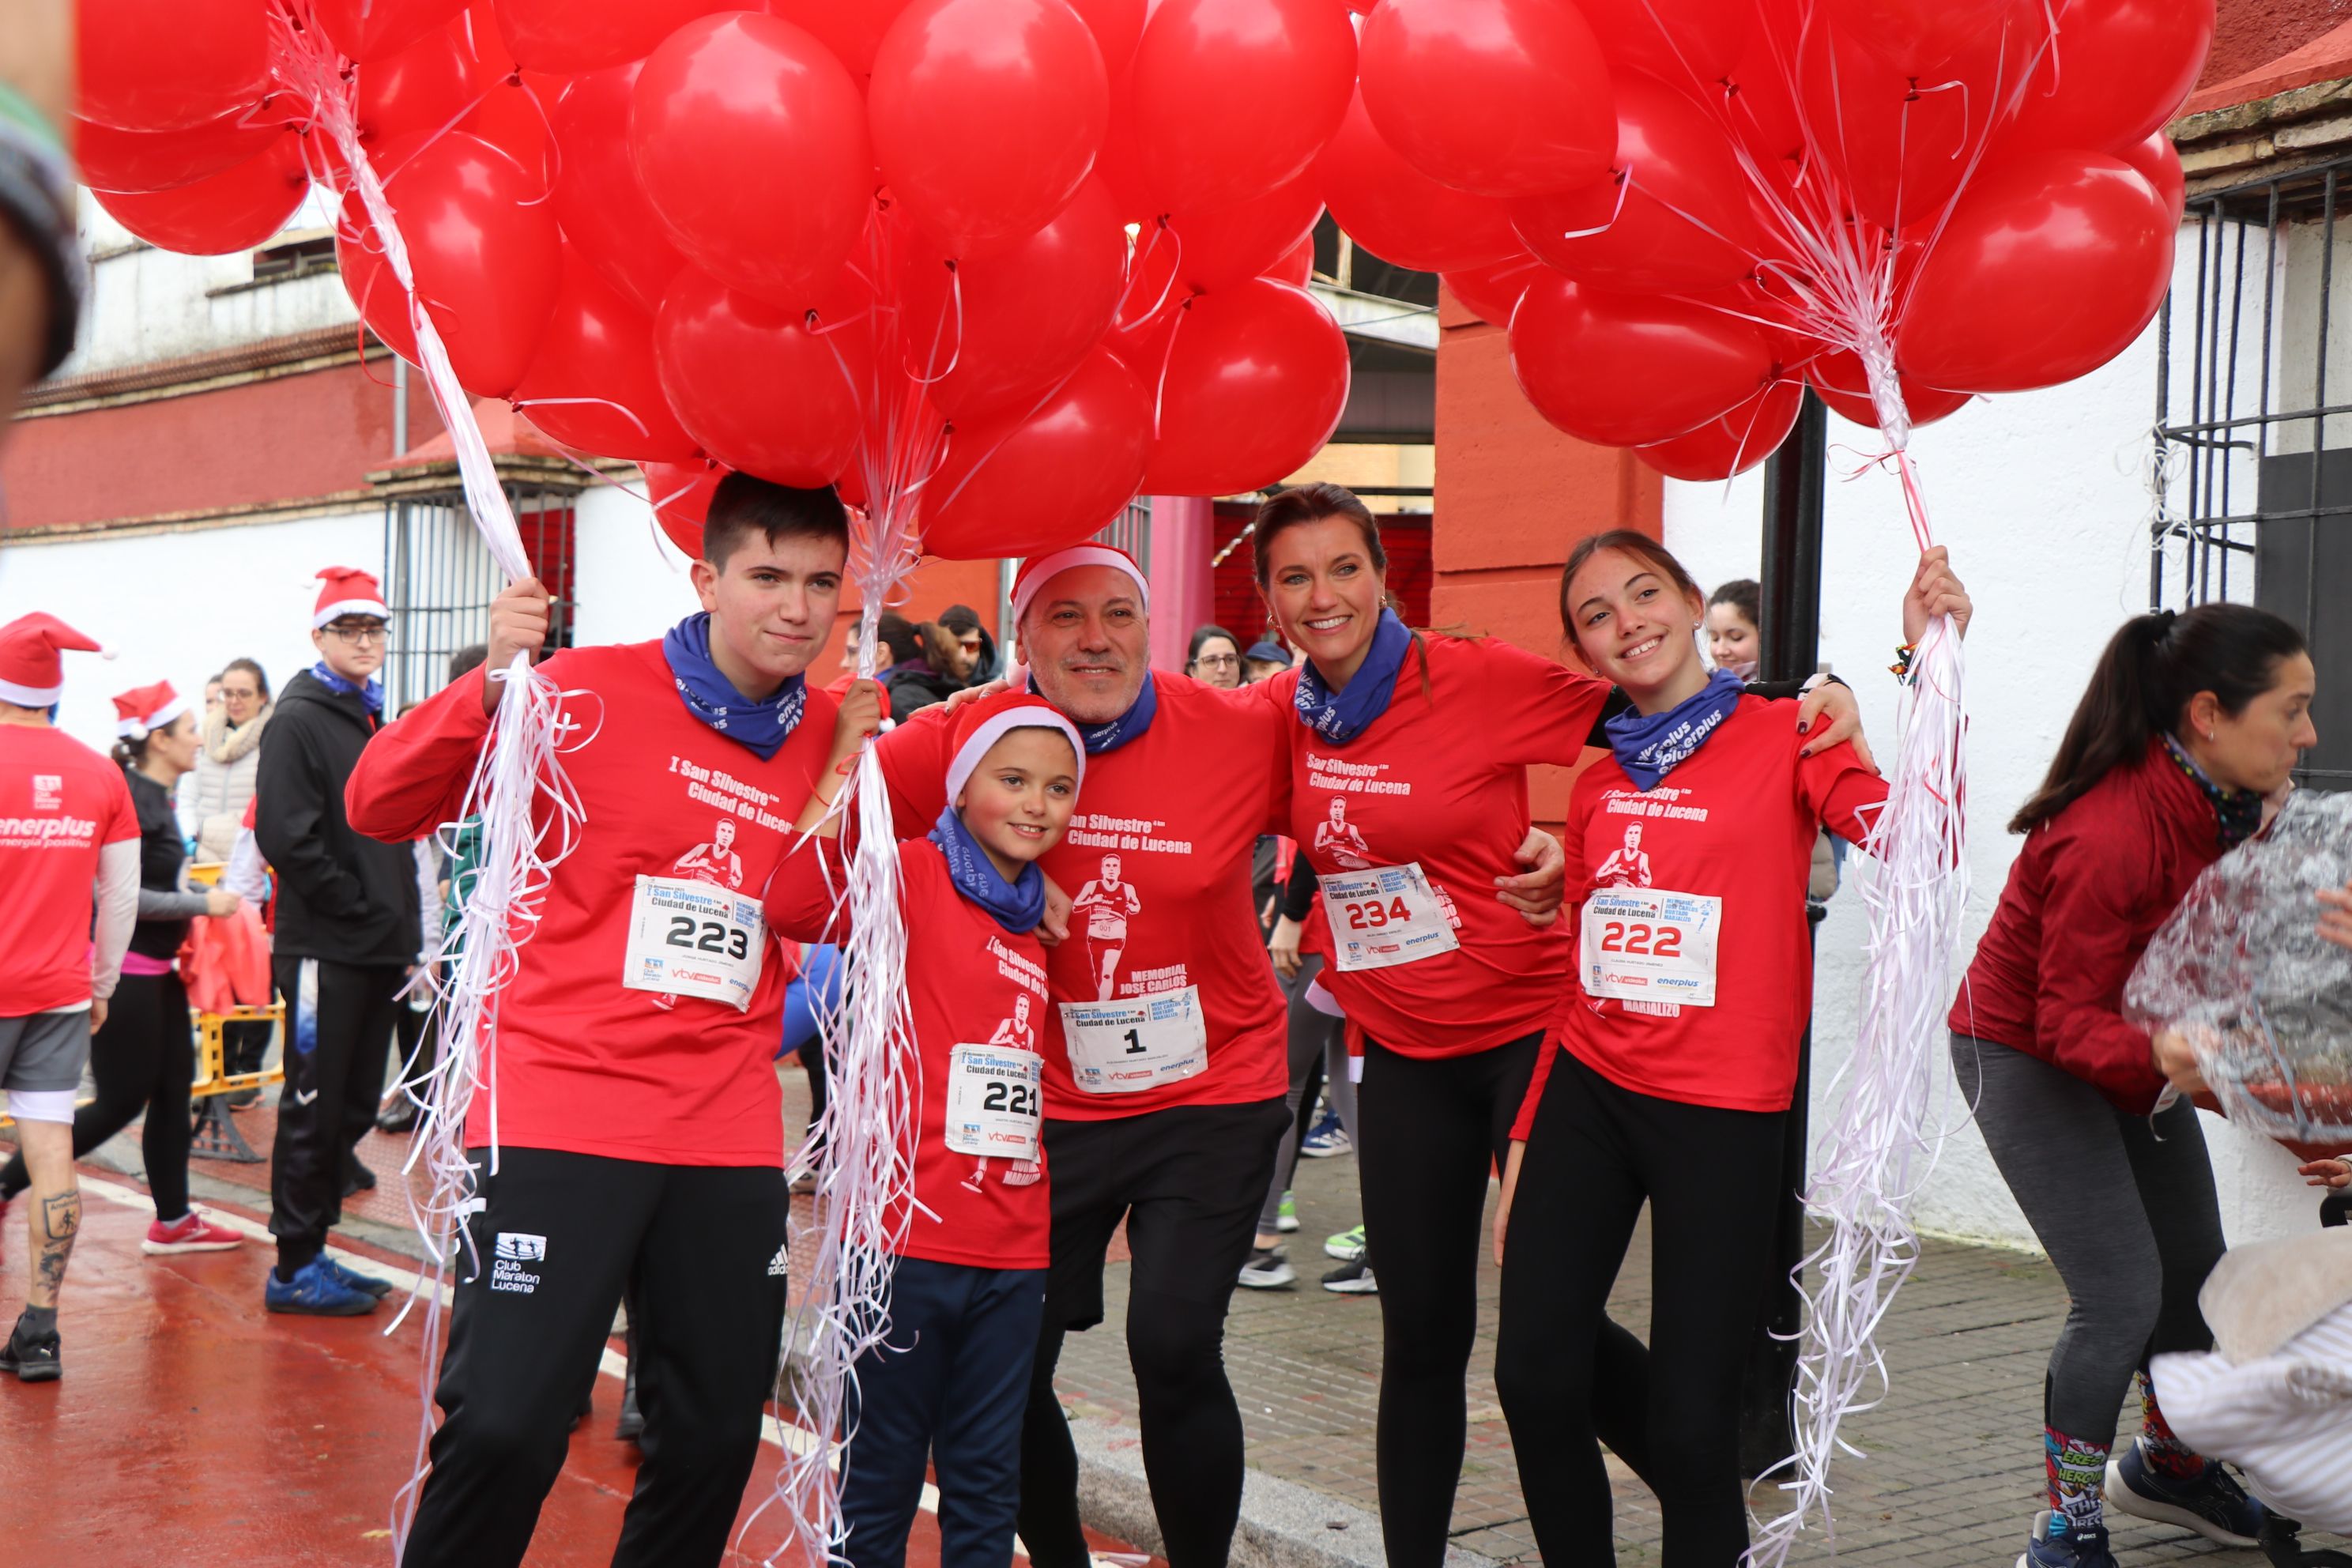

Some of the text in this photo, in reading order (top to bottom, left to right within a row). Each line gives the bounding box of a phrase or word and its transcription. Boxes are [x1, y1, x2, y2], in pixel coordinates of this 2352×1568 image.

[1325, 758, 1378, 777] Silvestre
[669, 755, 680, 773] I
[680, 760, 710, 783] San
[711, 770, 769, 806] Silvestre
[1310, 772, 1412, 796] Ciudad de Lucena
[688, 781, 793, 835] Ciudad de Lucen
[1606, 799, 1708, 822] Ciudad de Lucena
[1089, 813, 1152, 834] Silvestre
[1068, 830, 1192, 854] Ciudad de Lucena
[1339, 882, 1363, 891] Silvestre
[1357, 888, 1379, 897] Lucena
[646, 888, 651, 896] I
[654, 888, 671, 899] San
[673, 890, 713, 906] Silvestre
[1596, 897, 1608, 906] San
[1609, 898, 1640, 907] Silvestre
[651, 897, 729, 919] Ciudad de Lucena
[1345, 896, 1412, 929] 234
[1593, 906, 1656, 918] Ciudad de Lucena
[666, 916, 748, 960] 223
[1406, 932, 1439, 945] enerplus
[1601, 921, 1682, 958] 222
[986, 935, 1046, 982] I San Silvestre
[999, 959, 1030, 989] Ciudad
[1031, 978, 1041, 995] de
[1131, 963, 1187, 982] MEMORIAL
[1120, 982, 1146, 995] JOSE
[1148, 975, 1187, 993] CARLOS
[1657, 978, 1699, 987] enerplus
[1076, 1019, 1103, 1027] Ciudad
[1116, 1016, 1145, 1025] Lucena
[1091, 1010, 1127, 1019] Silvestre
[1124, 1028, 1147, 1054] 1
[968, 1055, 983, 1065] San
[985, 1057, 1016, 1069] Silvestre
[1160, 1058, 1195, 1072] enerplus
[967, 1065, 995, 1075] Ciudad
[997, 1068, 1005, 1076] de
[1007, 1070, 1027, 1080] Lucena
[983, 1082, 1038, 1118] 221
[495, 1259, 522, 1272] Club
[491, 1280, 534, 1294] Lucena
